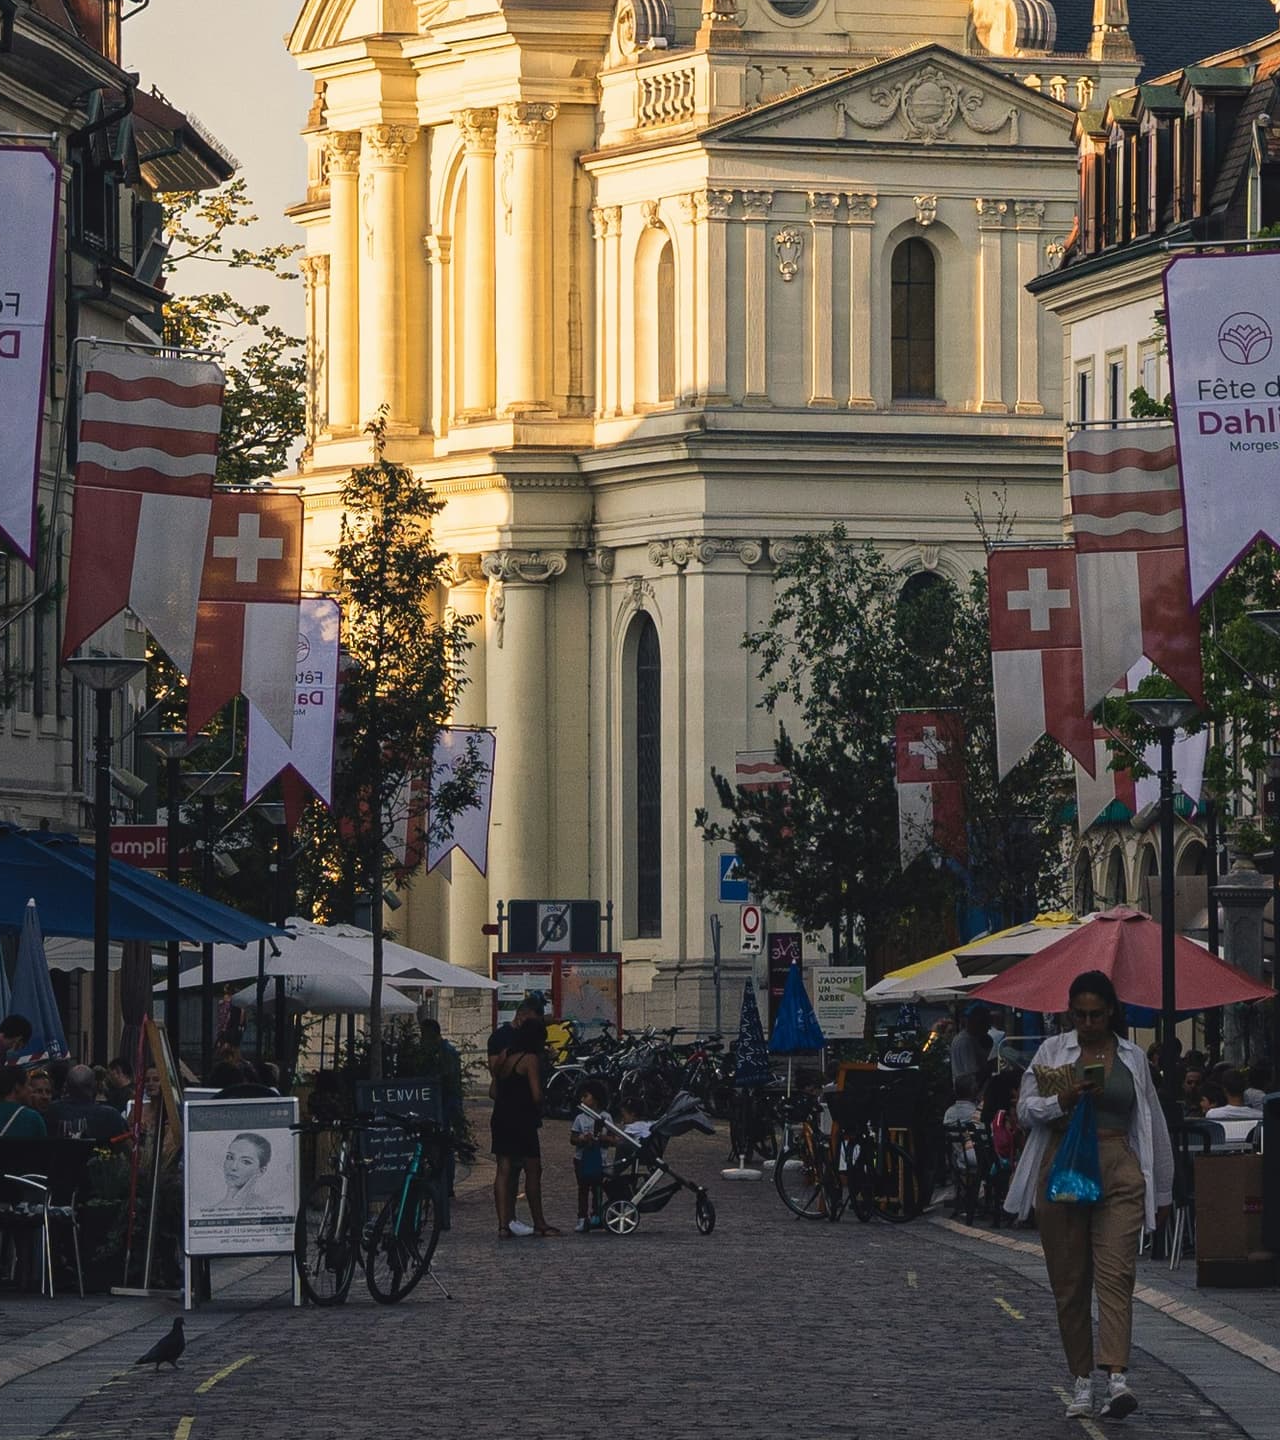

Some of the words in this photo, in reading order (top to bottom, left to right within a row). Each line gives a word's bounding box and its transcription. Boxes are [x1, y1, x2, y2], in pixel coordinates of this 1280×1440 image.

[1197, 378, 1256, 401] Fête
[1229, 441, 1279, 453] Morges
[371, 1087, 432, 1103] L'ENVIE
